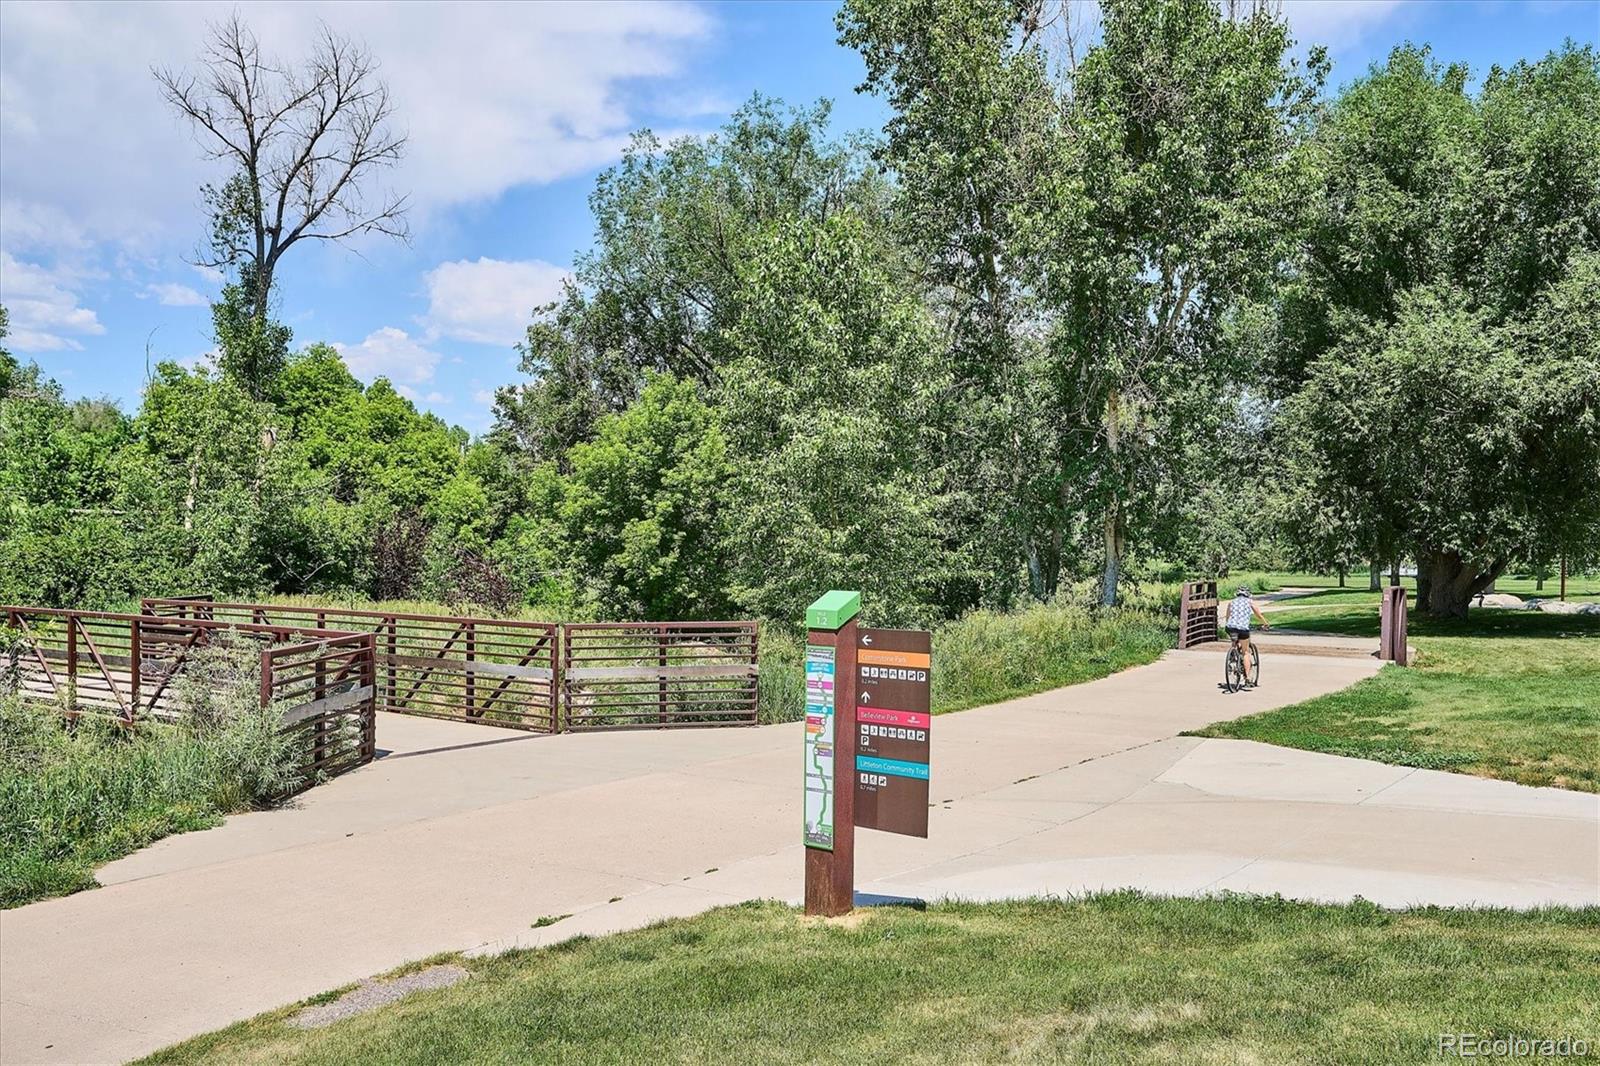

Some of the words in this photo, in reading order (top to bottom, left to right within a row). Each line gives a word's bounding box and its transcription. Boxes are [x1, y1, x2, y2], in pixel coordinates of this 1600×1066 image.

[887, 713, 899, 721] Park
[883, 762, 914, 774] Community
[915, 767, 928, 776] Trail
